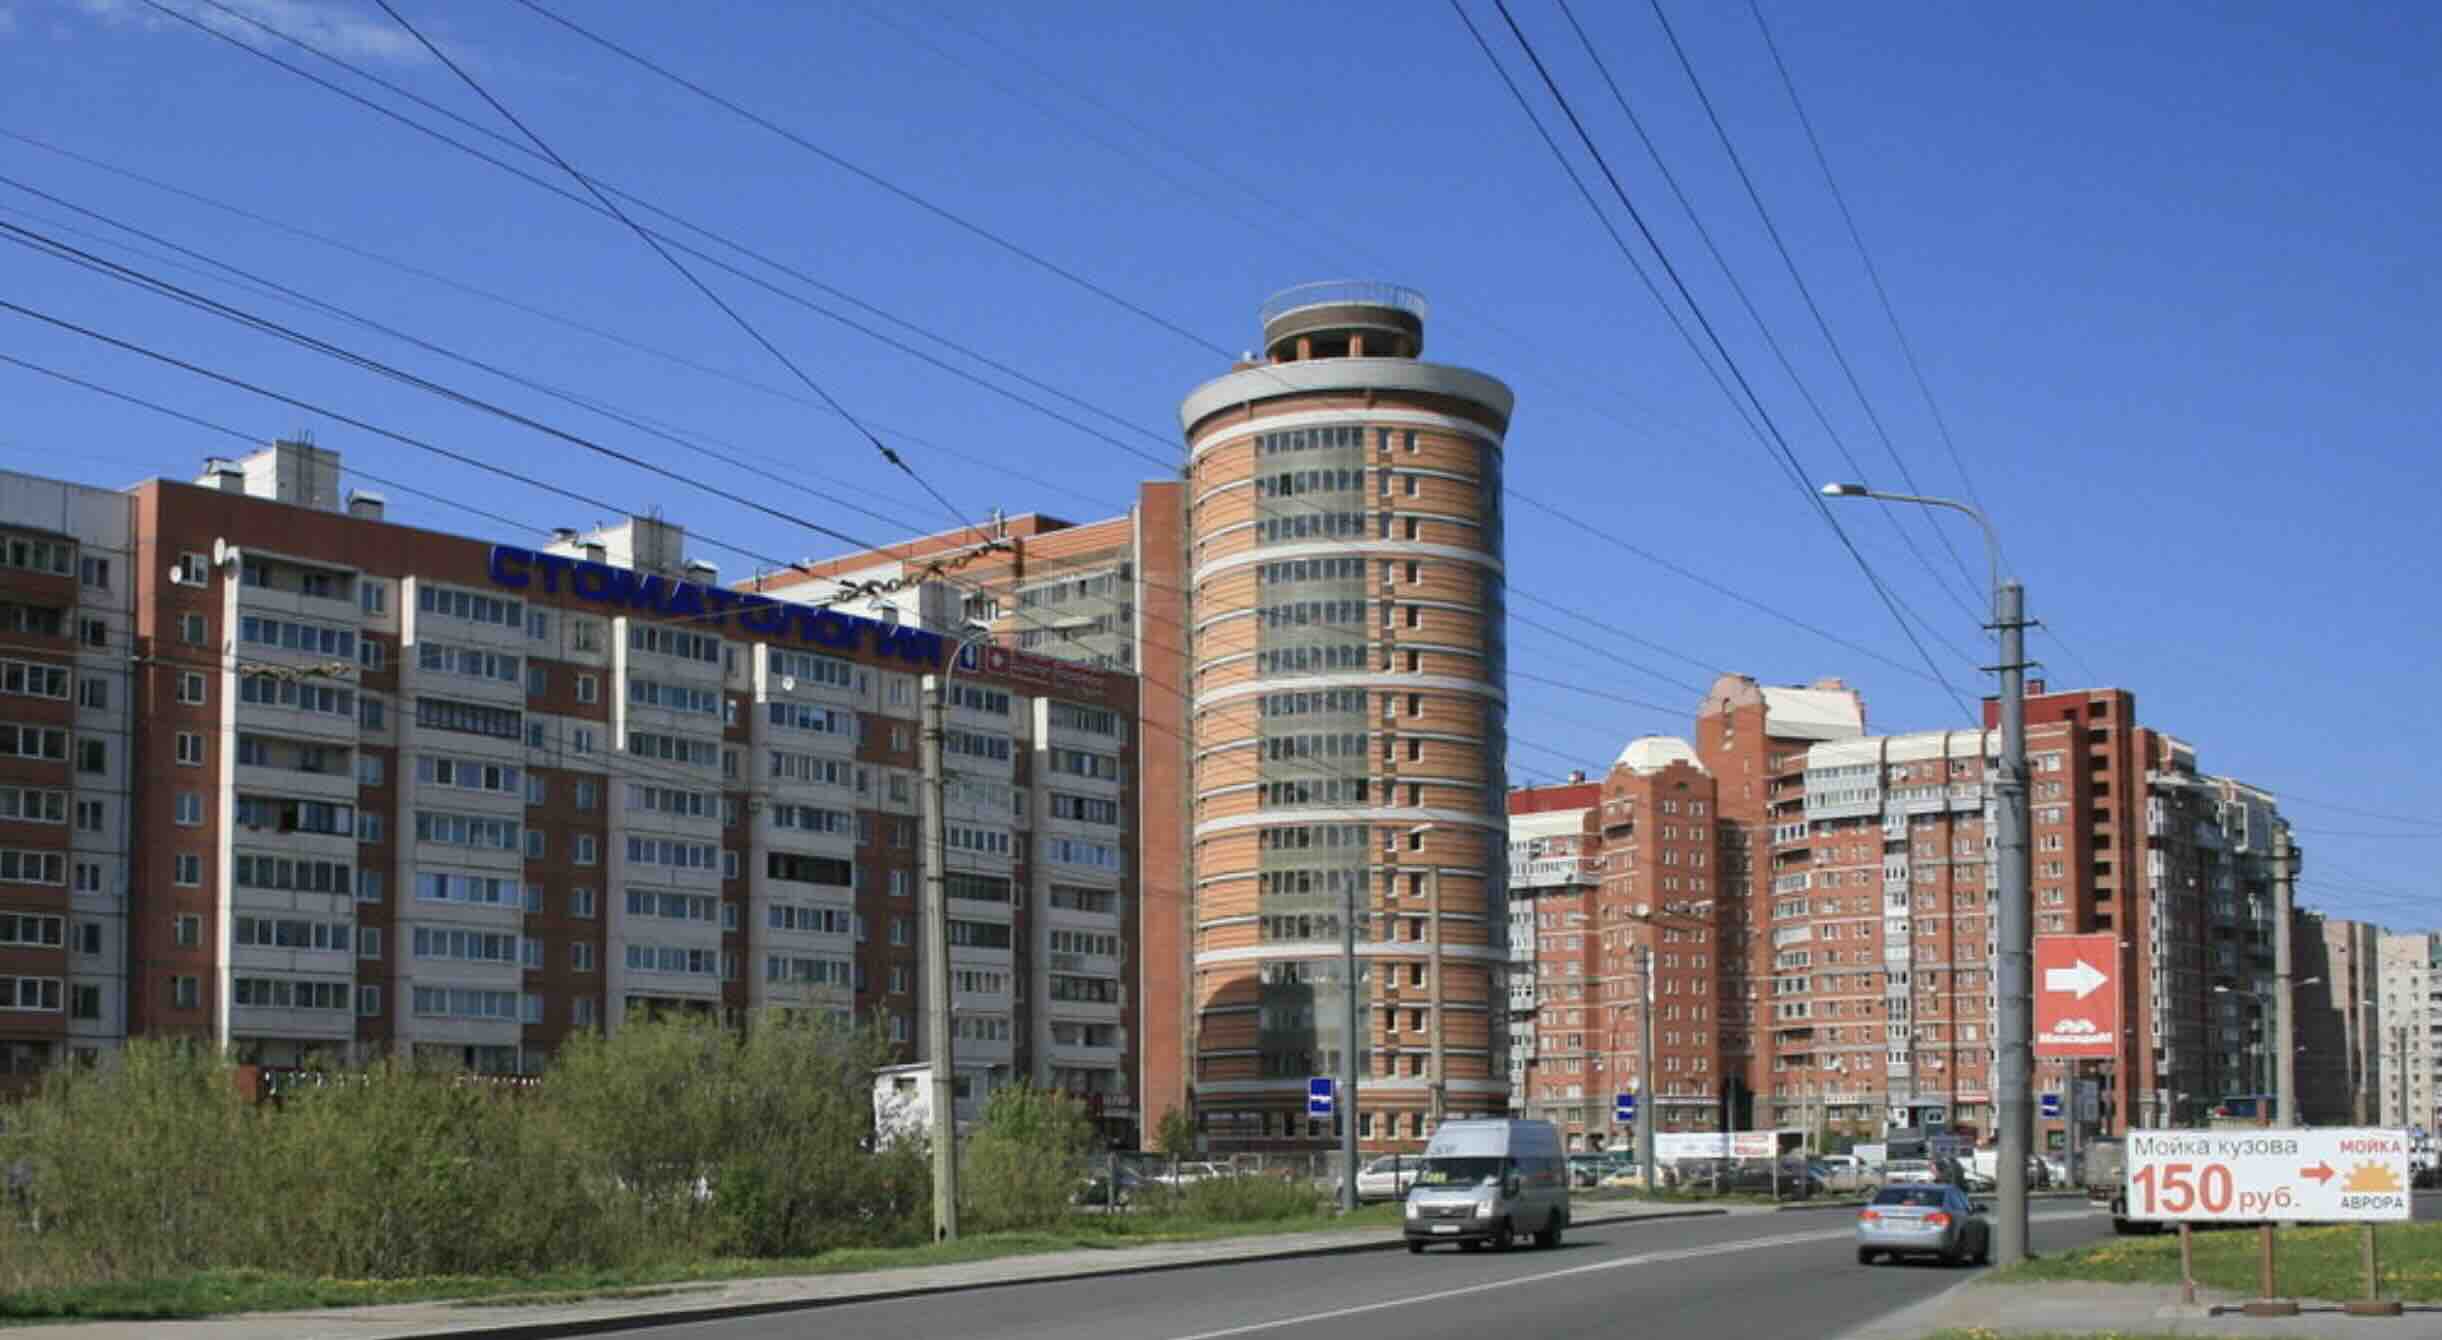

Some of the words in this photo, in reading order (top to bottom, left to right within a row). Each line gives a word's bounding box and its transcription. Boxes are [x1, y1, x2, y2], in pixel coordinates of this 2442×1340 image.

[488, 544, 942, 669] СТОМАТОЛОГИЯ
[2135, 1136, 2210, 1155] Мойка
[2218, 1139, 2298, 1160] кузова
[2132, 1163, 2233, 1214] 150
[2239, 1186, 2301, 1213] руб.
[2341, 1195, 2403, 1209] АВРОРА
